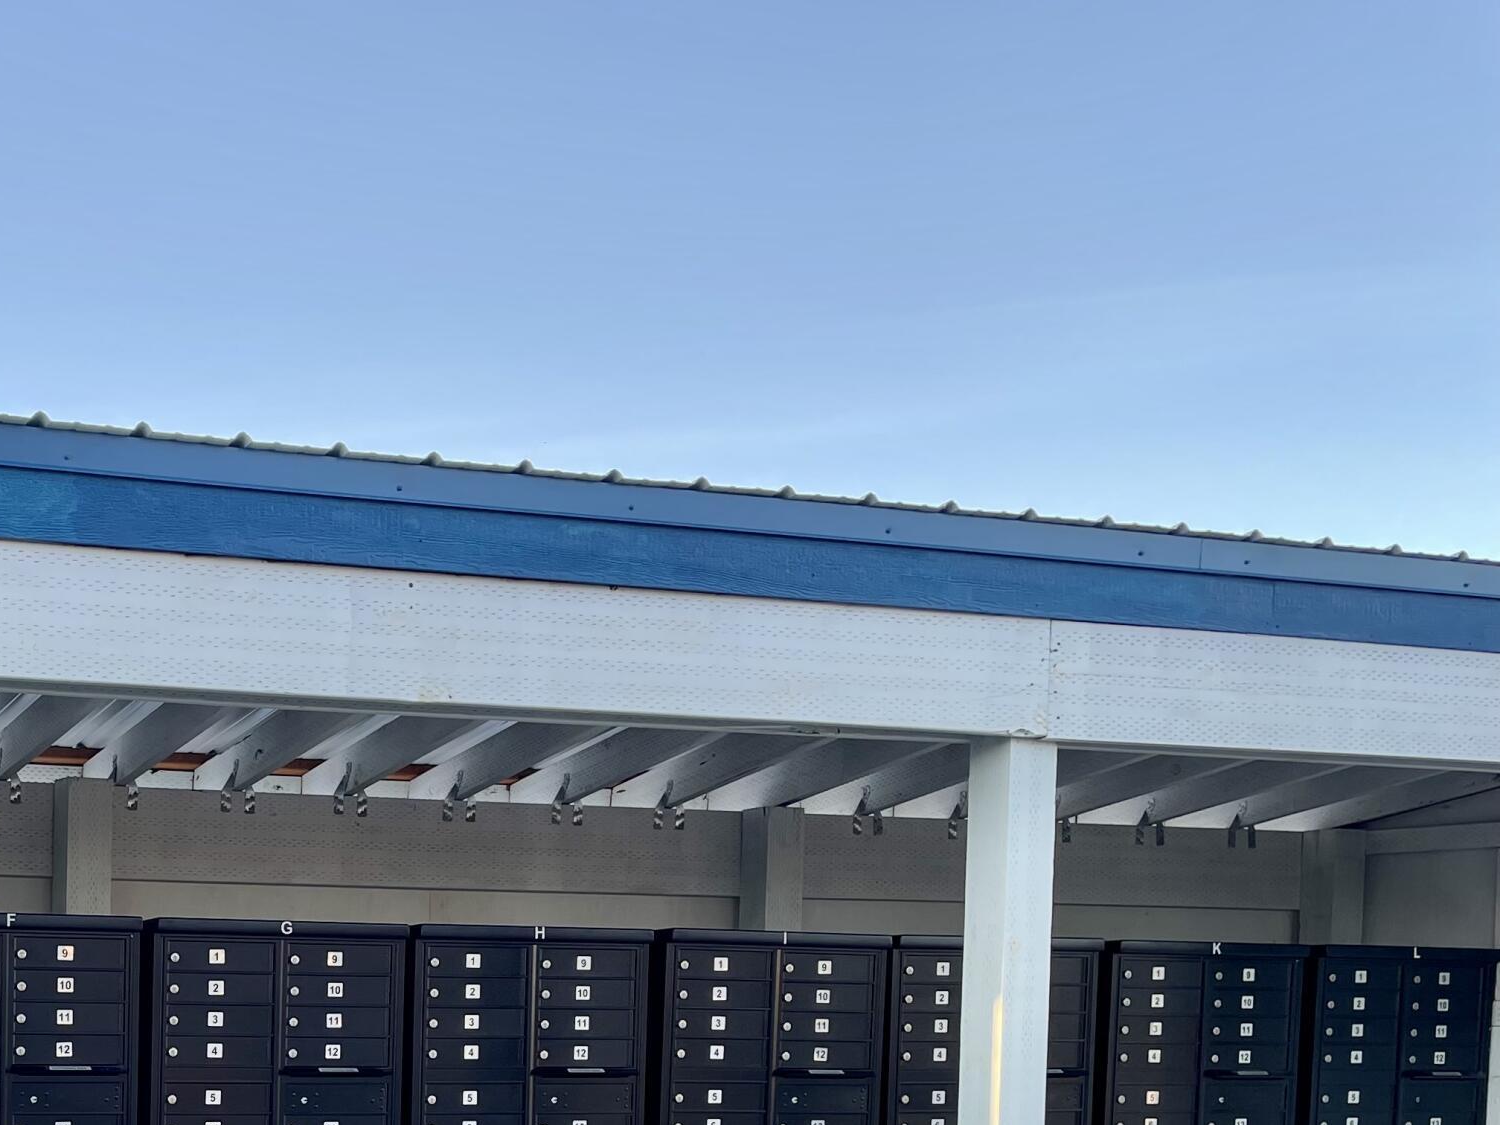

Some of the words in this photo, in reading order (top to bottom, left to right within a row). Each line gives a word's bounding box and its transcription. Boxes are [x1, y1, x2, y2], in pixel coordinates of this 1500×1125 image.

[6, 913, 17, 927] F
[280, 920, 293, 935] G
[534, 925, 546, 940] H
[59, 980, 72, 990] 10
[59, 1012, 70, 1022] 11
[58, 1044, 70, 1055] 12
